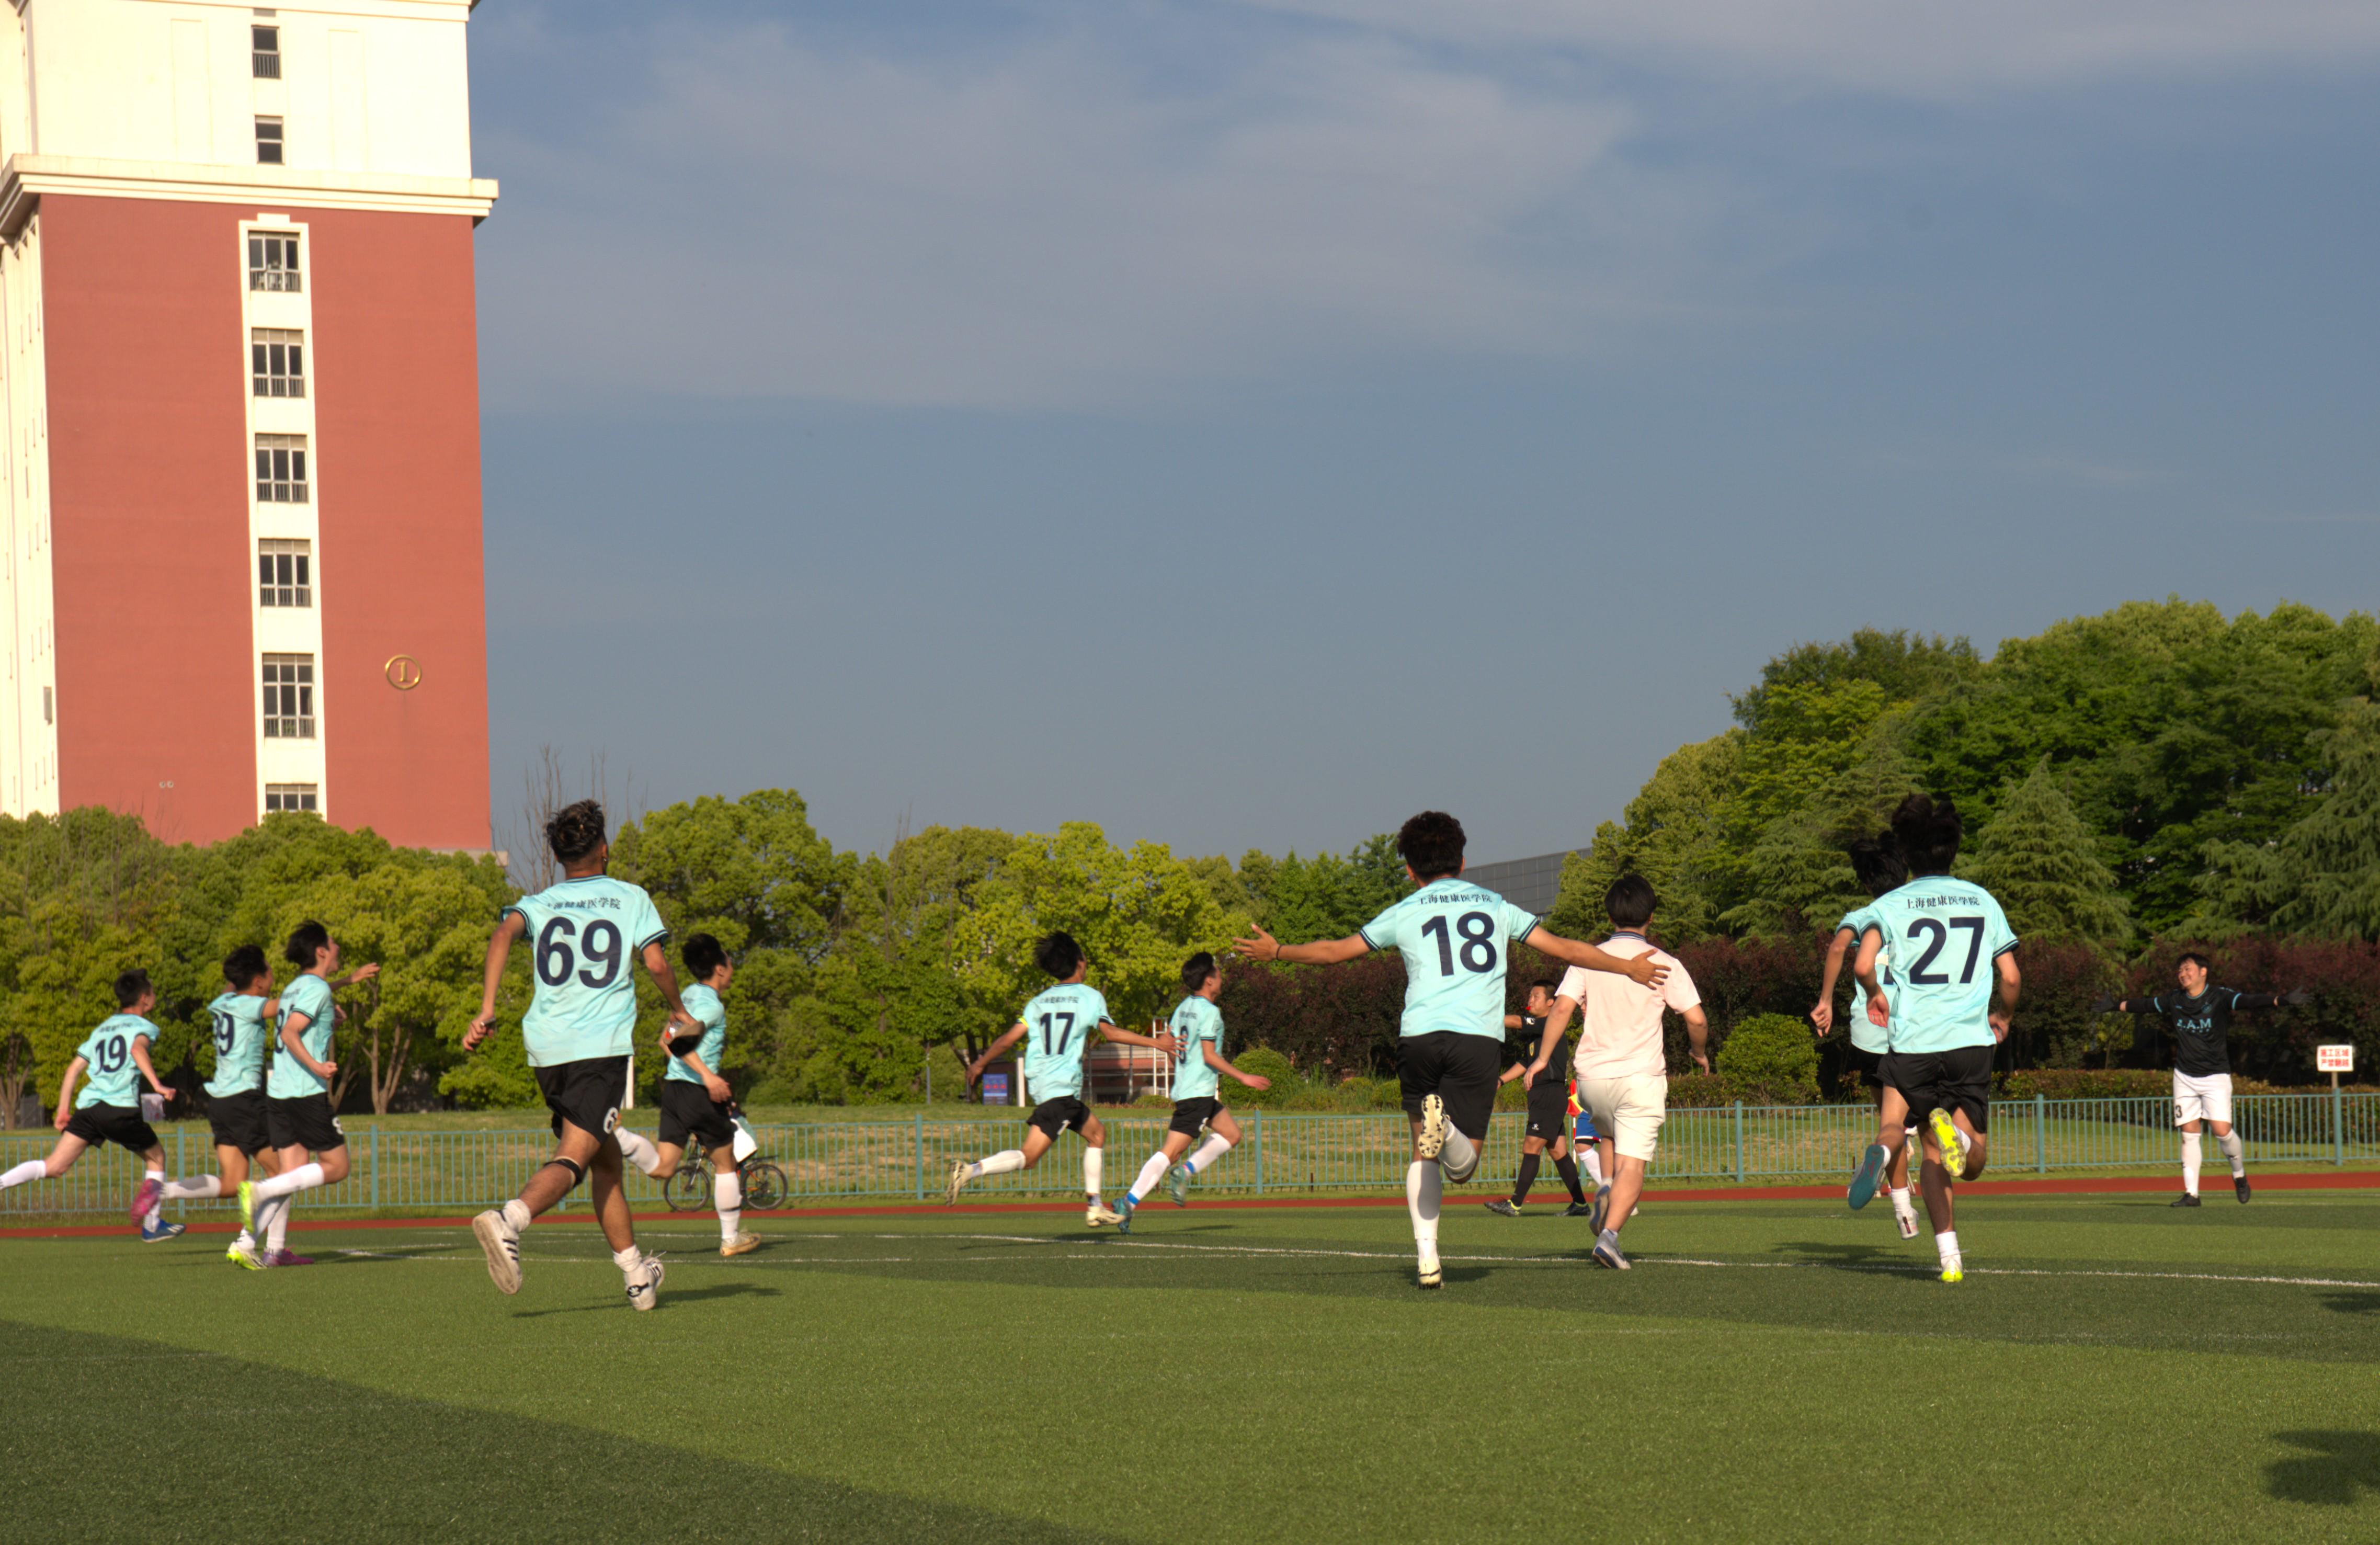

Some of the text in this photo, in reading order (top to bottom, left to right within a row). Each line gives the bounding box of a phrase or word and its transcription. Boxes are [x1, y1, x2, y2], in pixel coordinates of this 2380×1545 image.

[1420, 893, 1493, 904] 上海健康医学院
[1907, 895, 1980, 908] 上海健康医学院
[537, 916, 622, 989] 69
[1421, 912, 1497, 976] 18
[1907, 917, 1985, 984] 27
[94, 1035, 127, 1075] 19
[1040, 1013, 1075, 1055] 17
